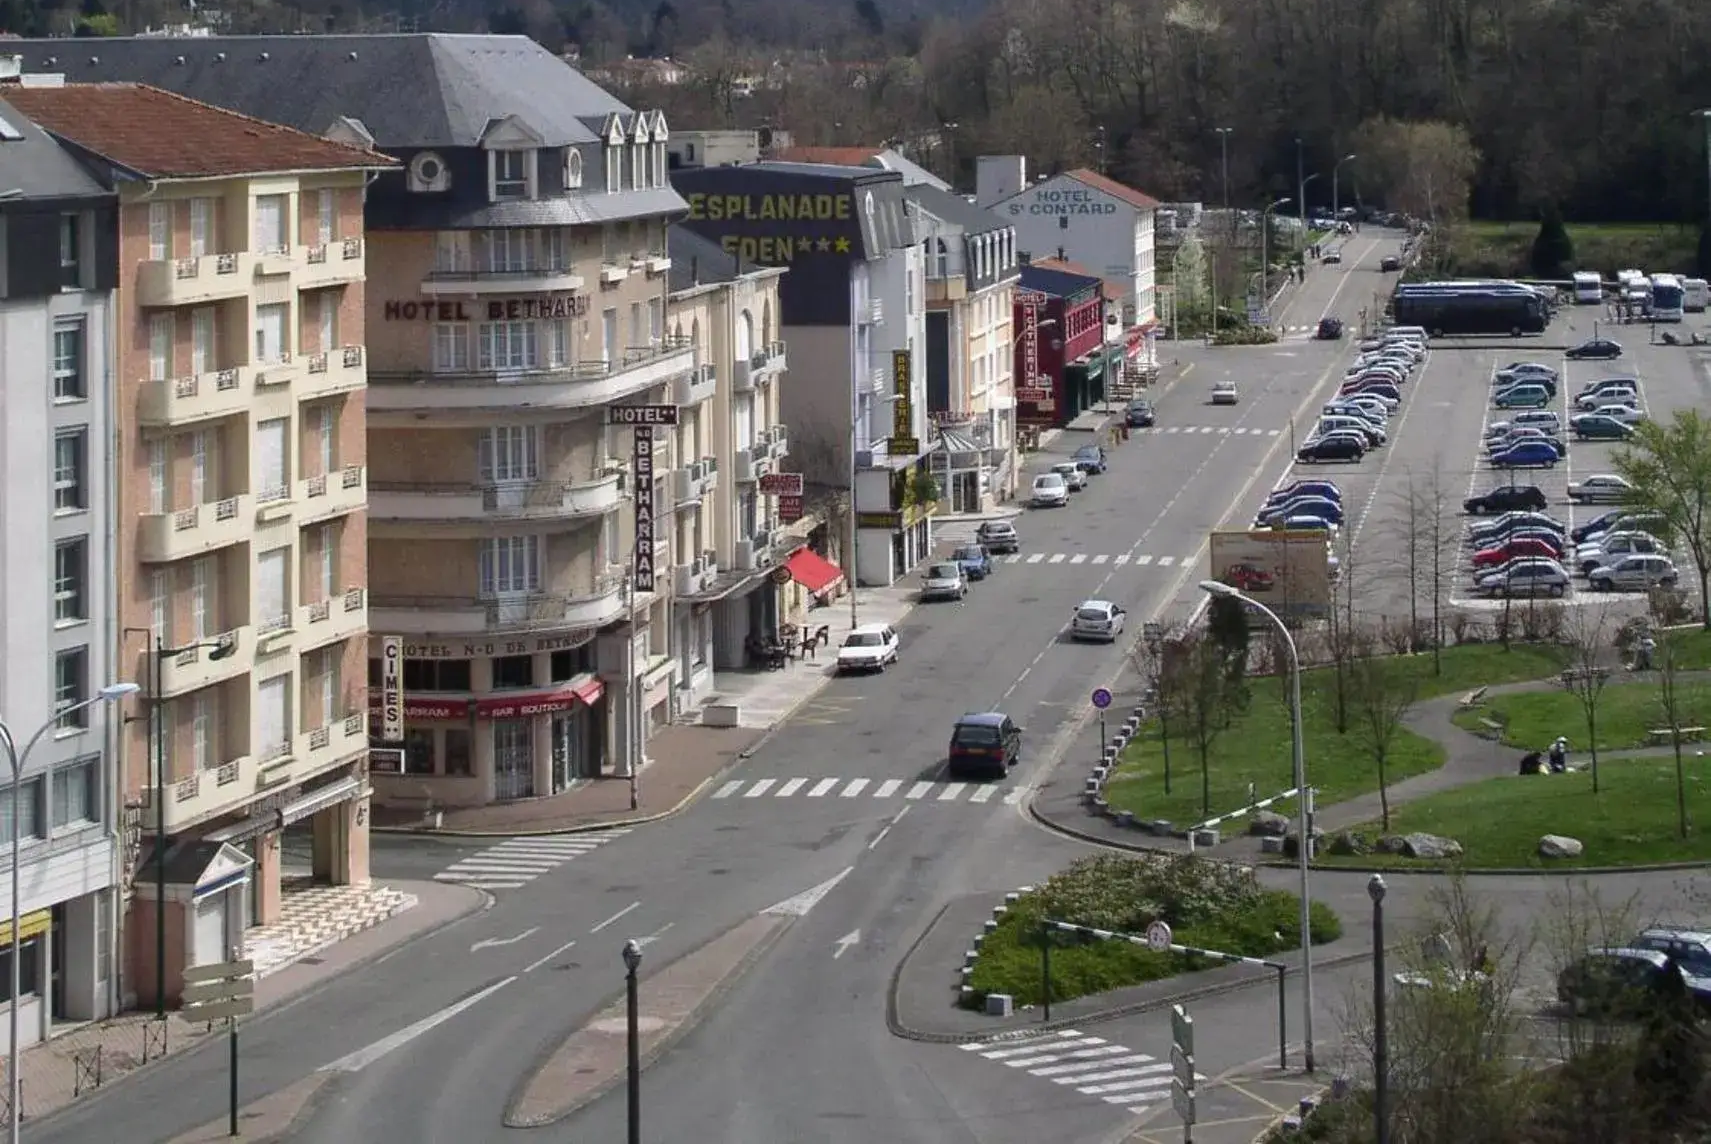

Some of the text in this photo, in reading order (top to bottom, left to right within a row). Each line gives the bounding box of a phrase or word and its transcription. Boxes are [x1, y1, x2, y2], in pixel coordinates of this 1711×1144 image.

[689, 193, 850, 220] ESPLANADE
[1037, 190, 1093, 203] HOTEL
[1030, 203, 1117, 216] CONTARD
[385, 299, 470, 321] HOTEL
[613, 408, 665, 422] HOTEL
[637, 440, 653, 587] BETHARRAM
[386, 644, 397, 721] CIMES
